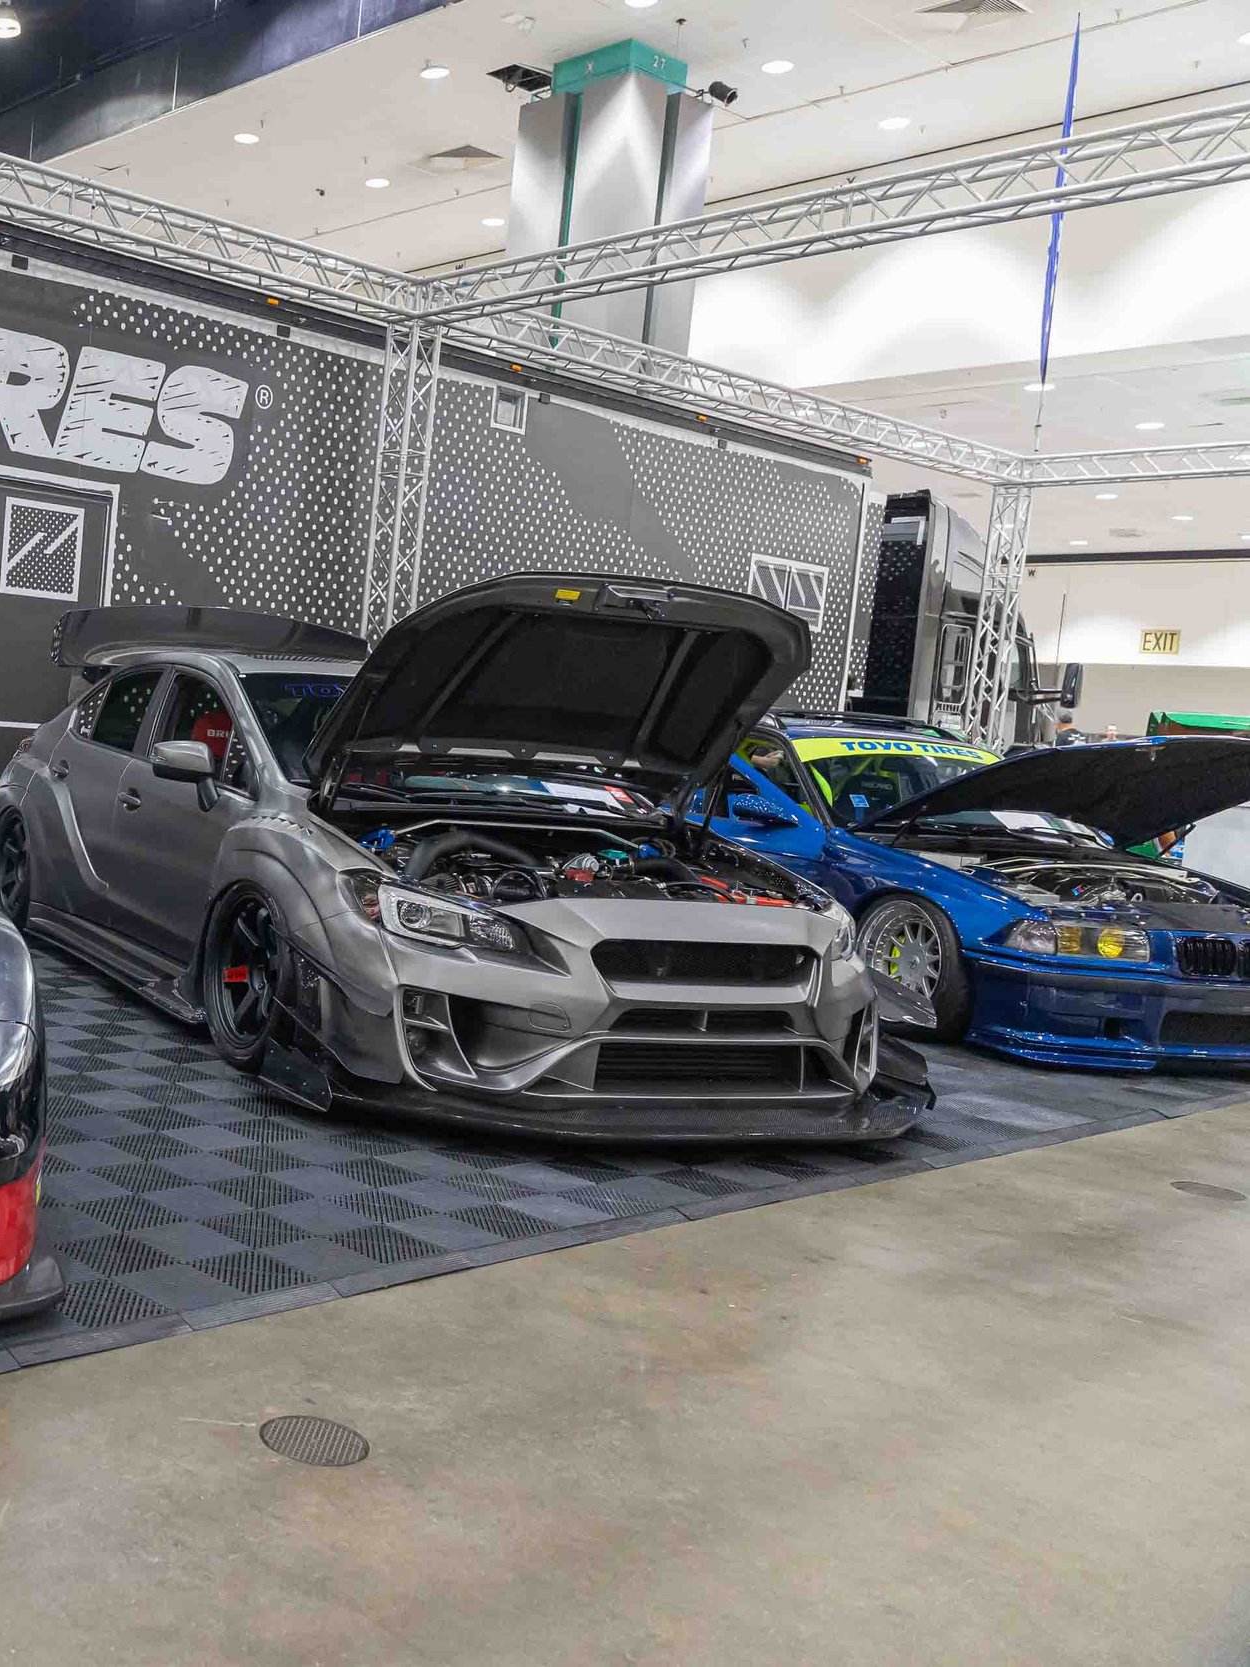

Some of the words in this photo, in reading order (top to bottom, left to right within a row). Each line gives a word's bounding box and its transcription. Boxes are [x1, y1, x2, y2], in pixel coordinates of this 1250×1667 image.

[653, 55, 666, 70] 27
[1028, 569, 1036, 577] W
[1142, 632, 1177, 651] EXIT
[207, 729, 229, 738] BRI
[840, 740, 913, 751] TOYO
[917, 743, 984, 760] TIRES
